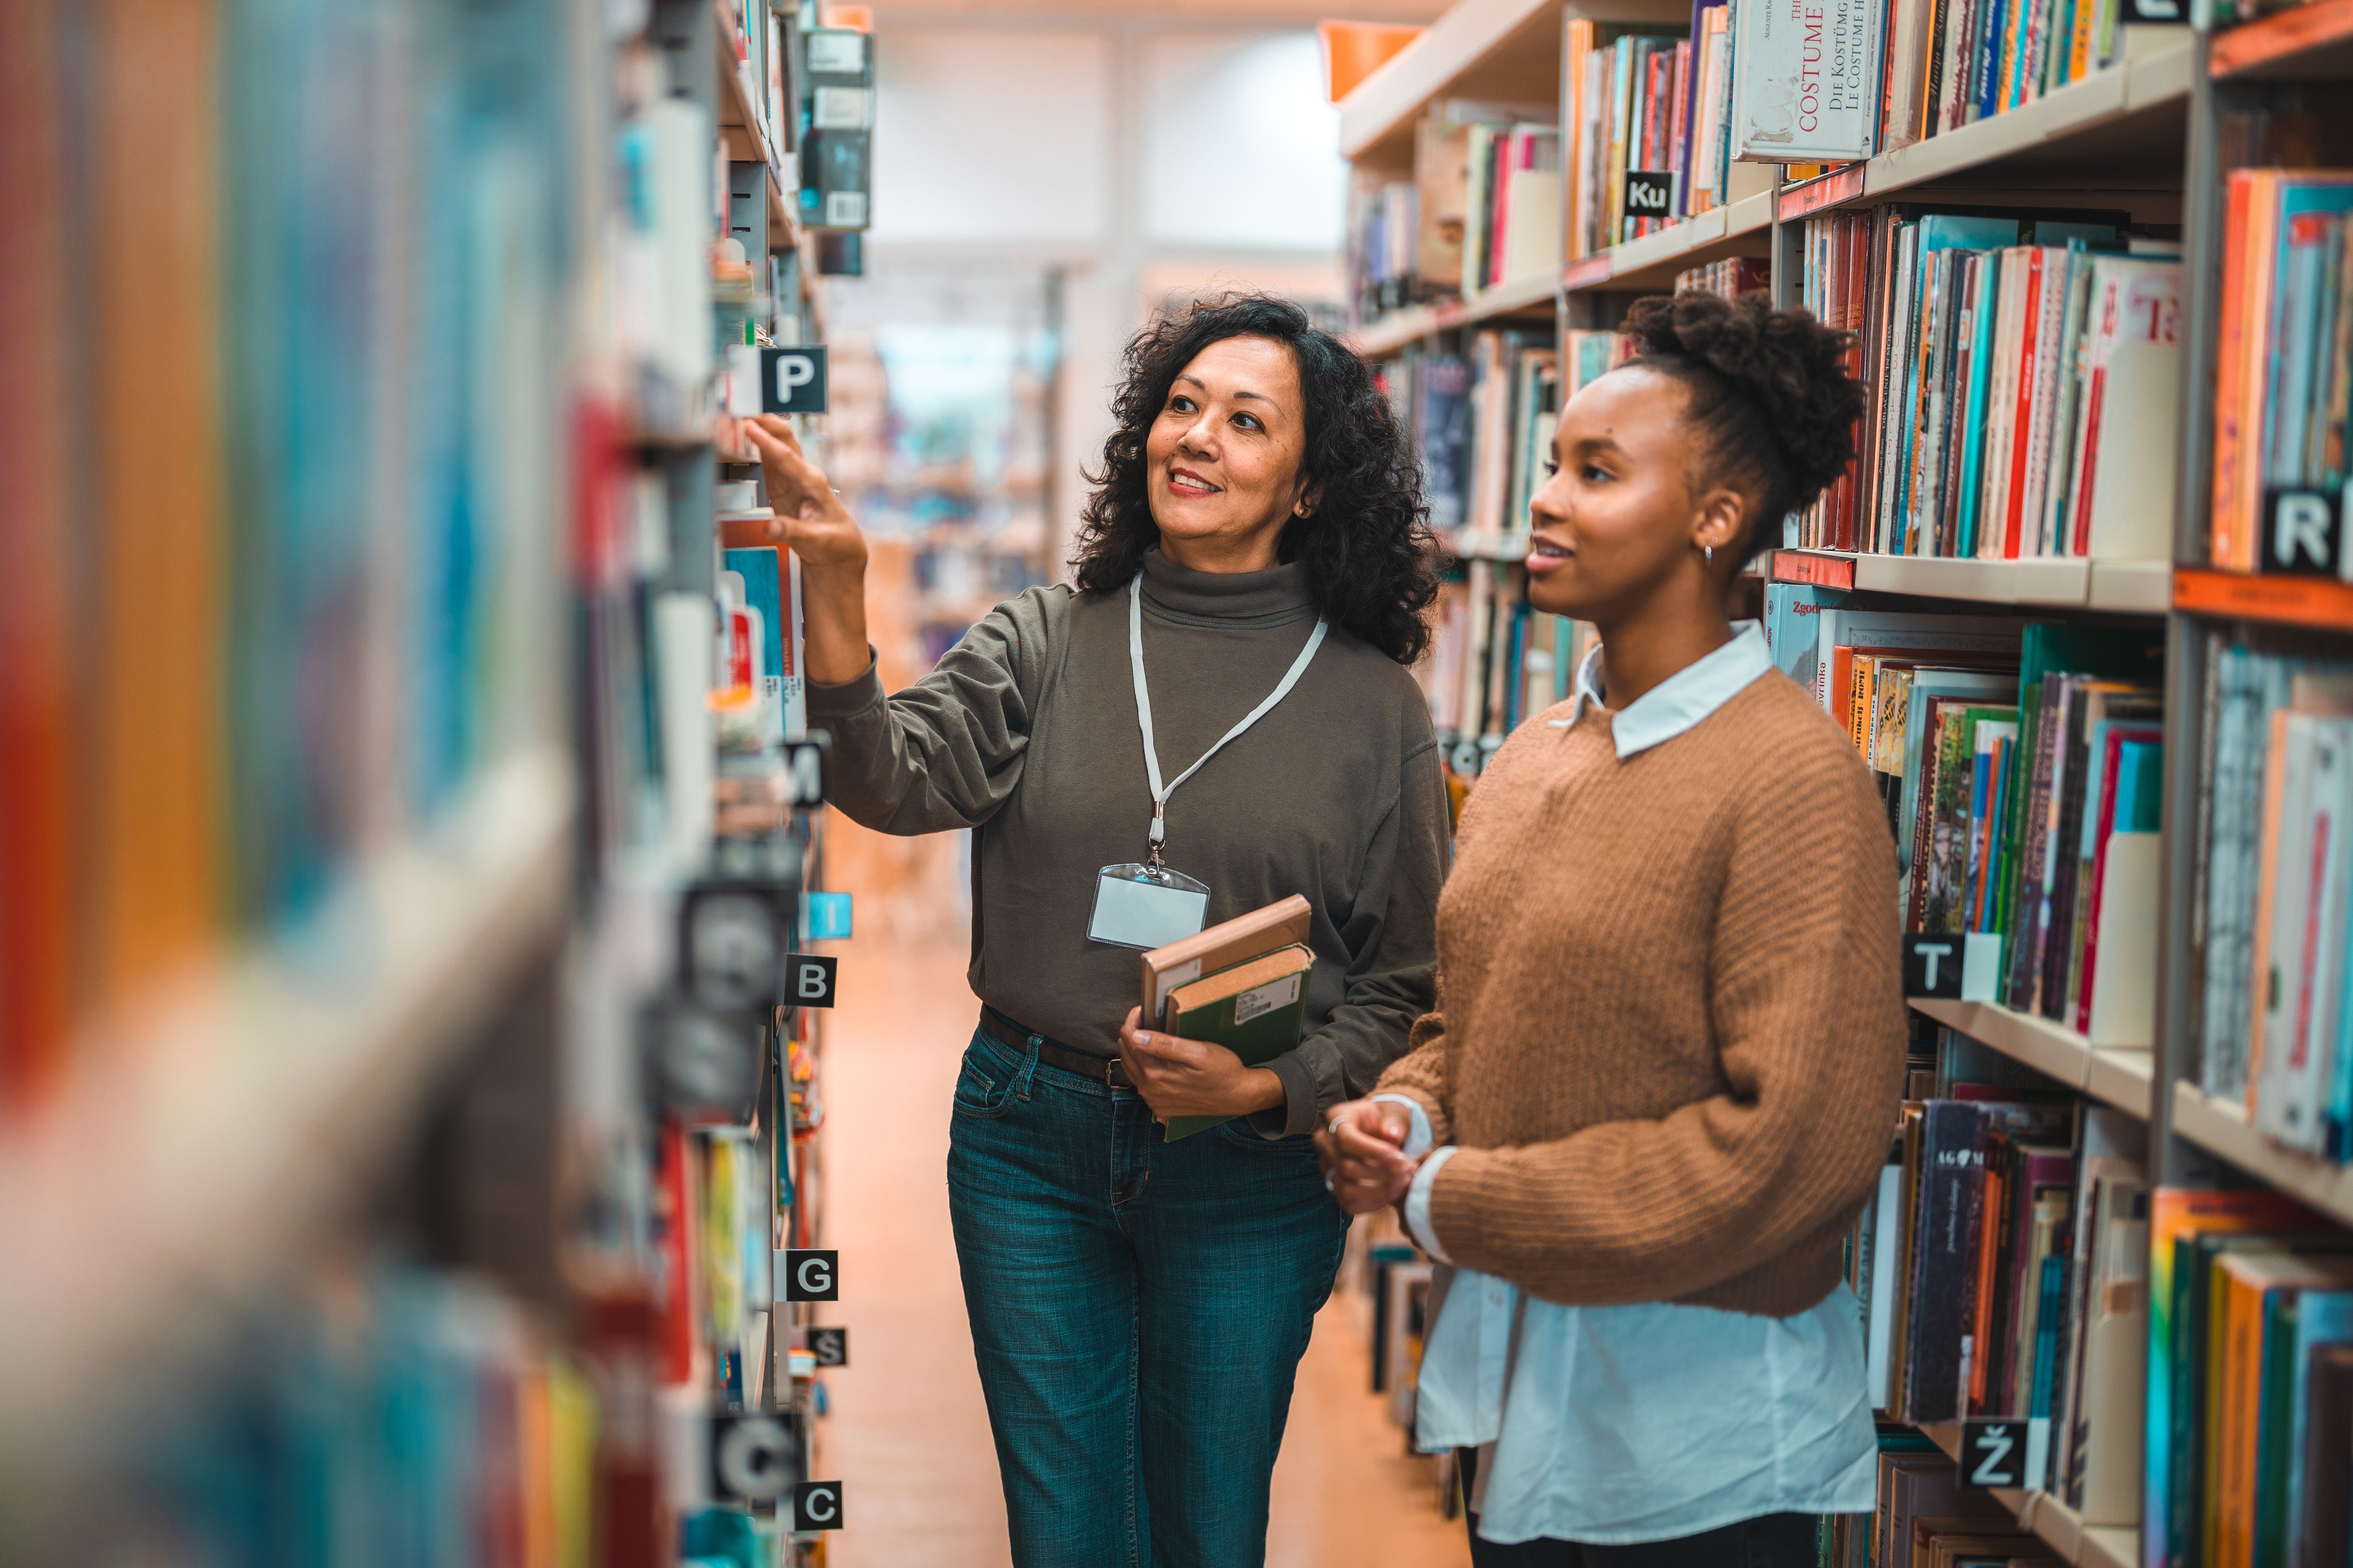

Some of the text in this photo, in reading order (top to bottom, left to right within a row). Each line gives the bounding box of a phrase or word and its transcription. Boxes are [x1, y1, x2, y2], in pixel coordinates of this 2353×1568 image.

[1799, 7, 1823, 132] COSTUME
[1829, 0, 1848, 111] DIE KOSTÜMG
[1847, 15, 1864, 88] COSTUME
[1846, 93, 1859, 111] LE
[1629, 181, 1667, 208] Ku
[776, 354, 815, 404] P
[1885, 358, 1890, 369] IN
[1881, 371, 1890, 429] OBLAČENJE
[2274, 493, 2333, 569] R
[798, 964, 827, 998] B
[1914, 943, 1953, 991] T
[797, 1258, 831, 1293] G
[1971, 1423, 2015, 1485] Ž
[805, 1488, 836, 1523] C
